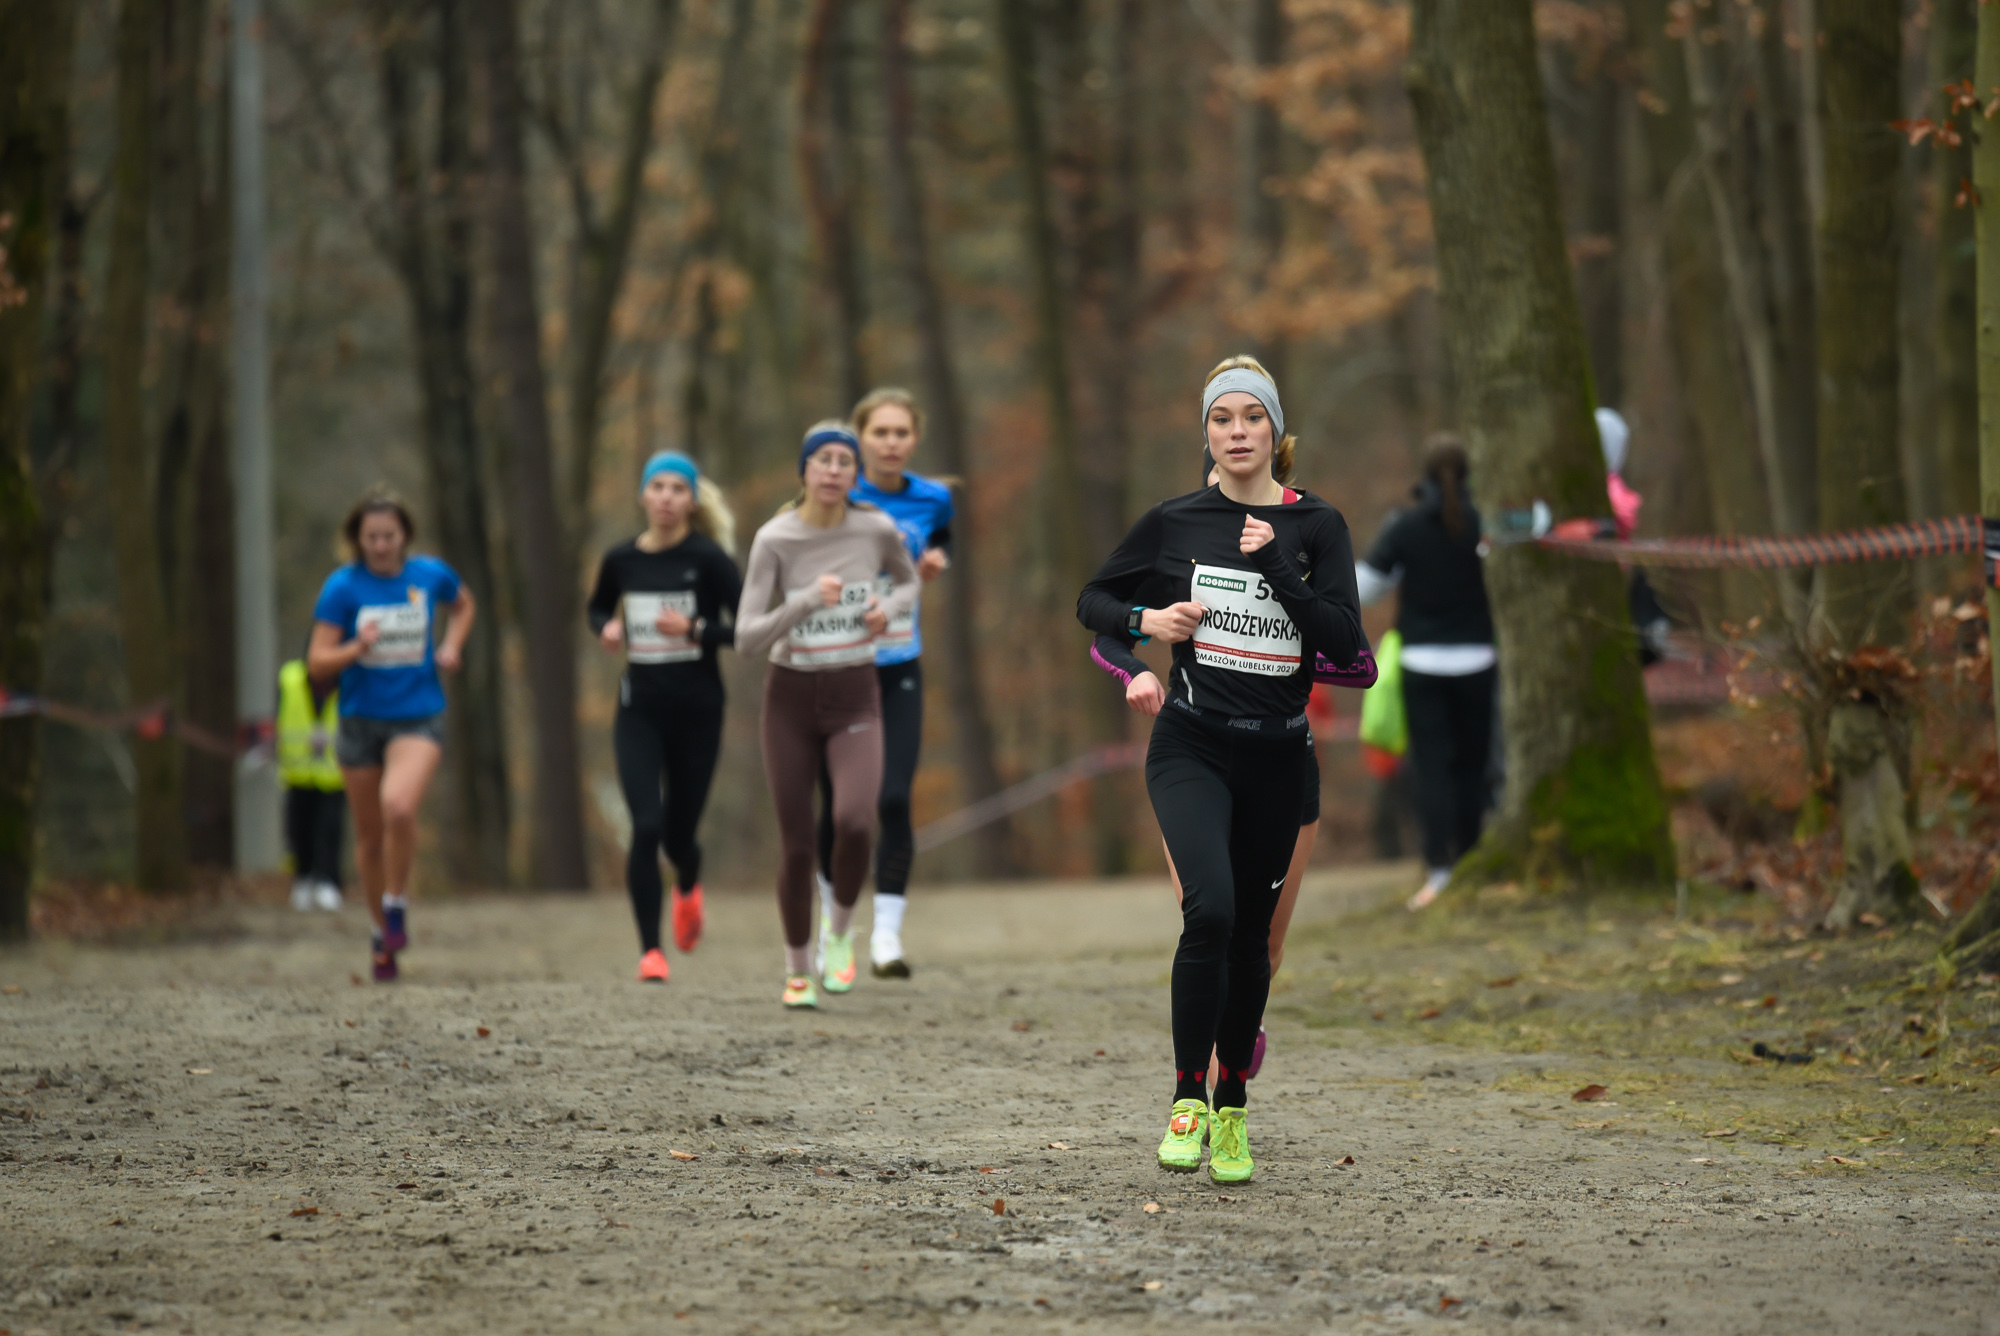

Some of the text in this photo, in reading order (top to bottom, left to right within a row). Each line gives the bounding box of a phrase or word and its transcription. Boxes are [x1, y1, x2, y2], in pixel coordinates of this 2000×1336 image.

[1199, 576, 1245, 591] BOGDANKA
[1195, 651, 1295, 673] OMASZÓW LUBELSKI 2021
[1228, 716, 1262, 731] NIKE
